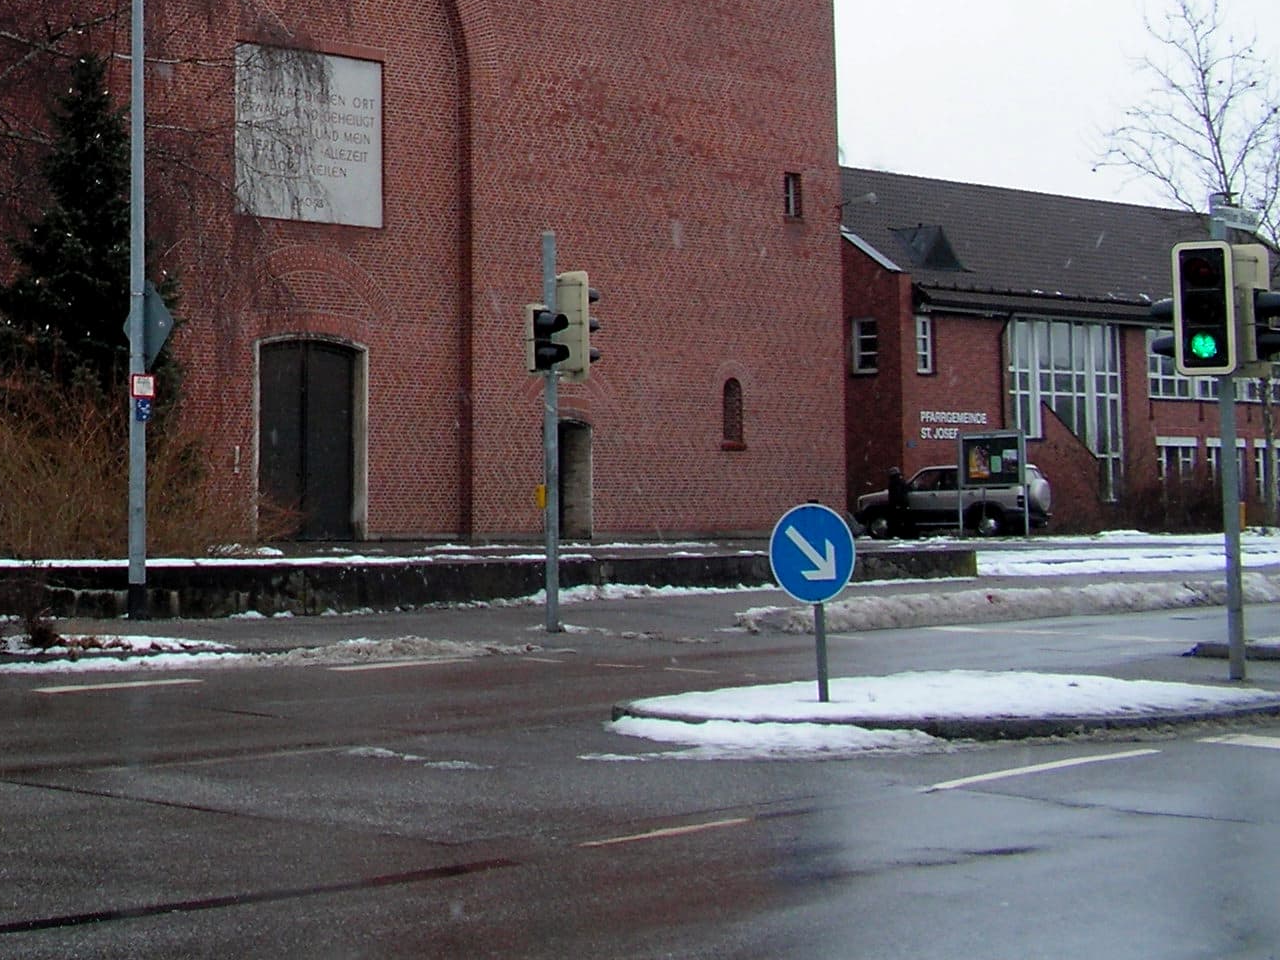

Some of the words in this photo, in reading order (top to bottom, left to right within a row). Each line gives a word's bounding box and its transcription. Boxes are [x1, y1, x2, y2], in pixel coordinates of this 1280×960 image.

[352, 97, 376, 110] ORT
[344, 131, 371, 145] MEIN
[324, 147, 368, 162] ALLEZEIT
[920, 411, 987, 424] PFARRGEMEINDE
[934, 427, 959, 440] JOSEF
